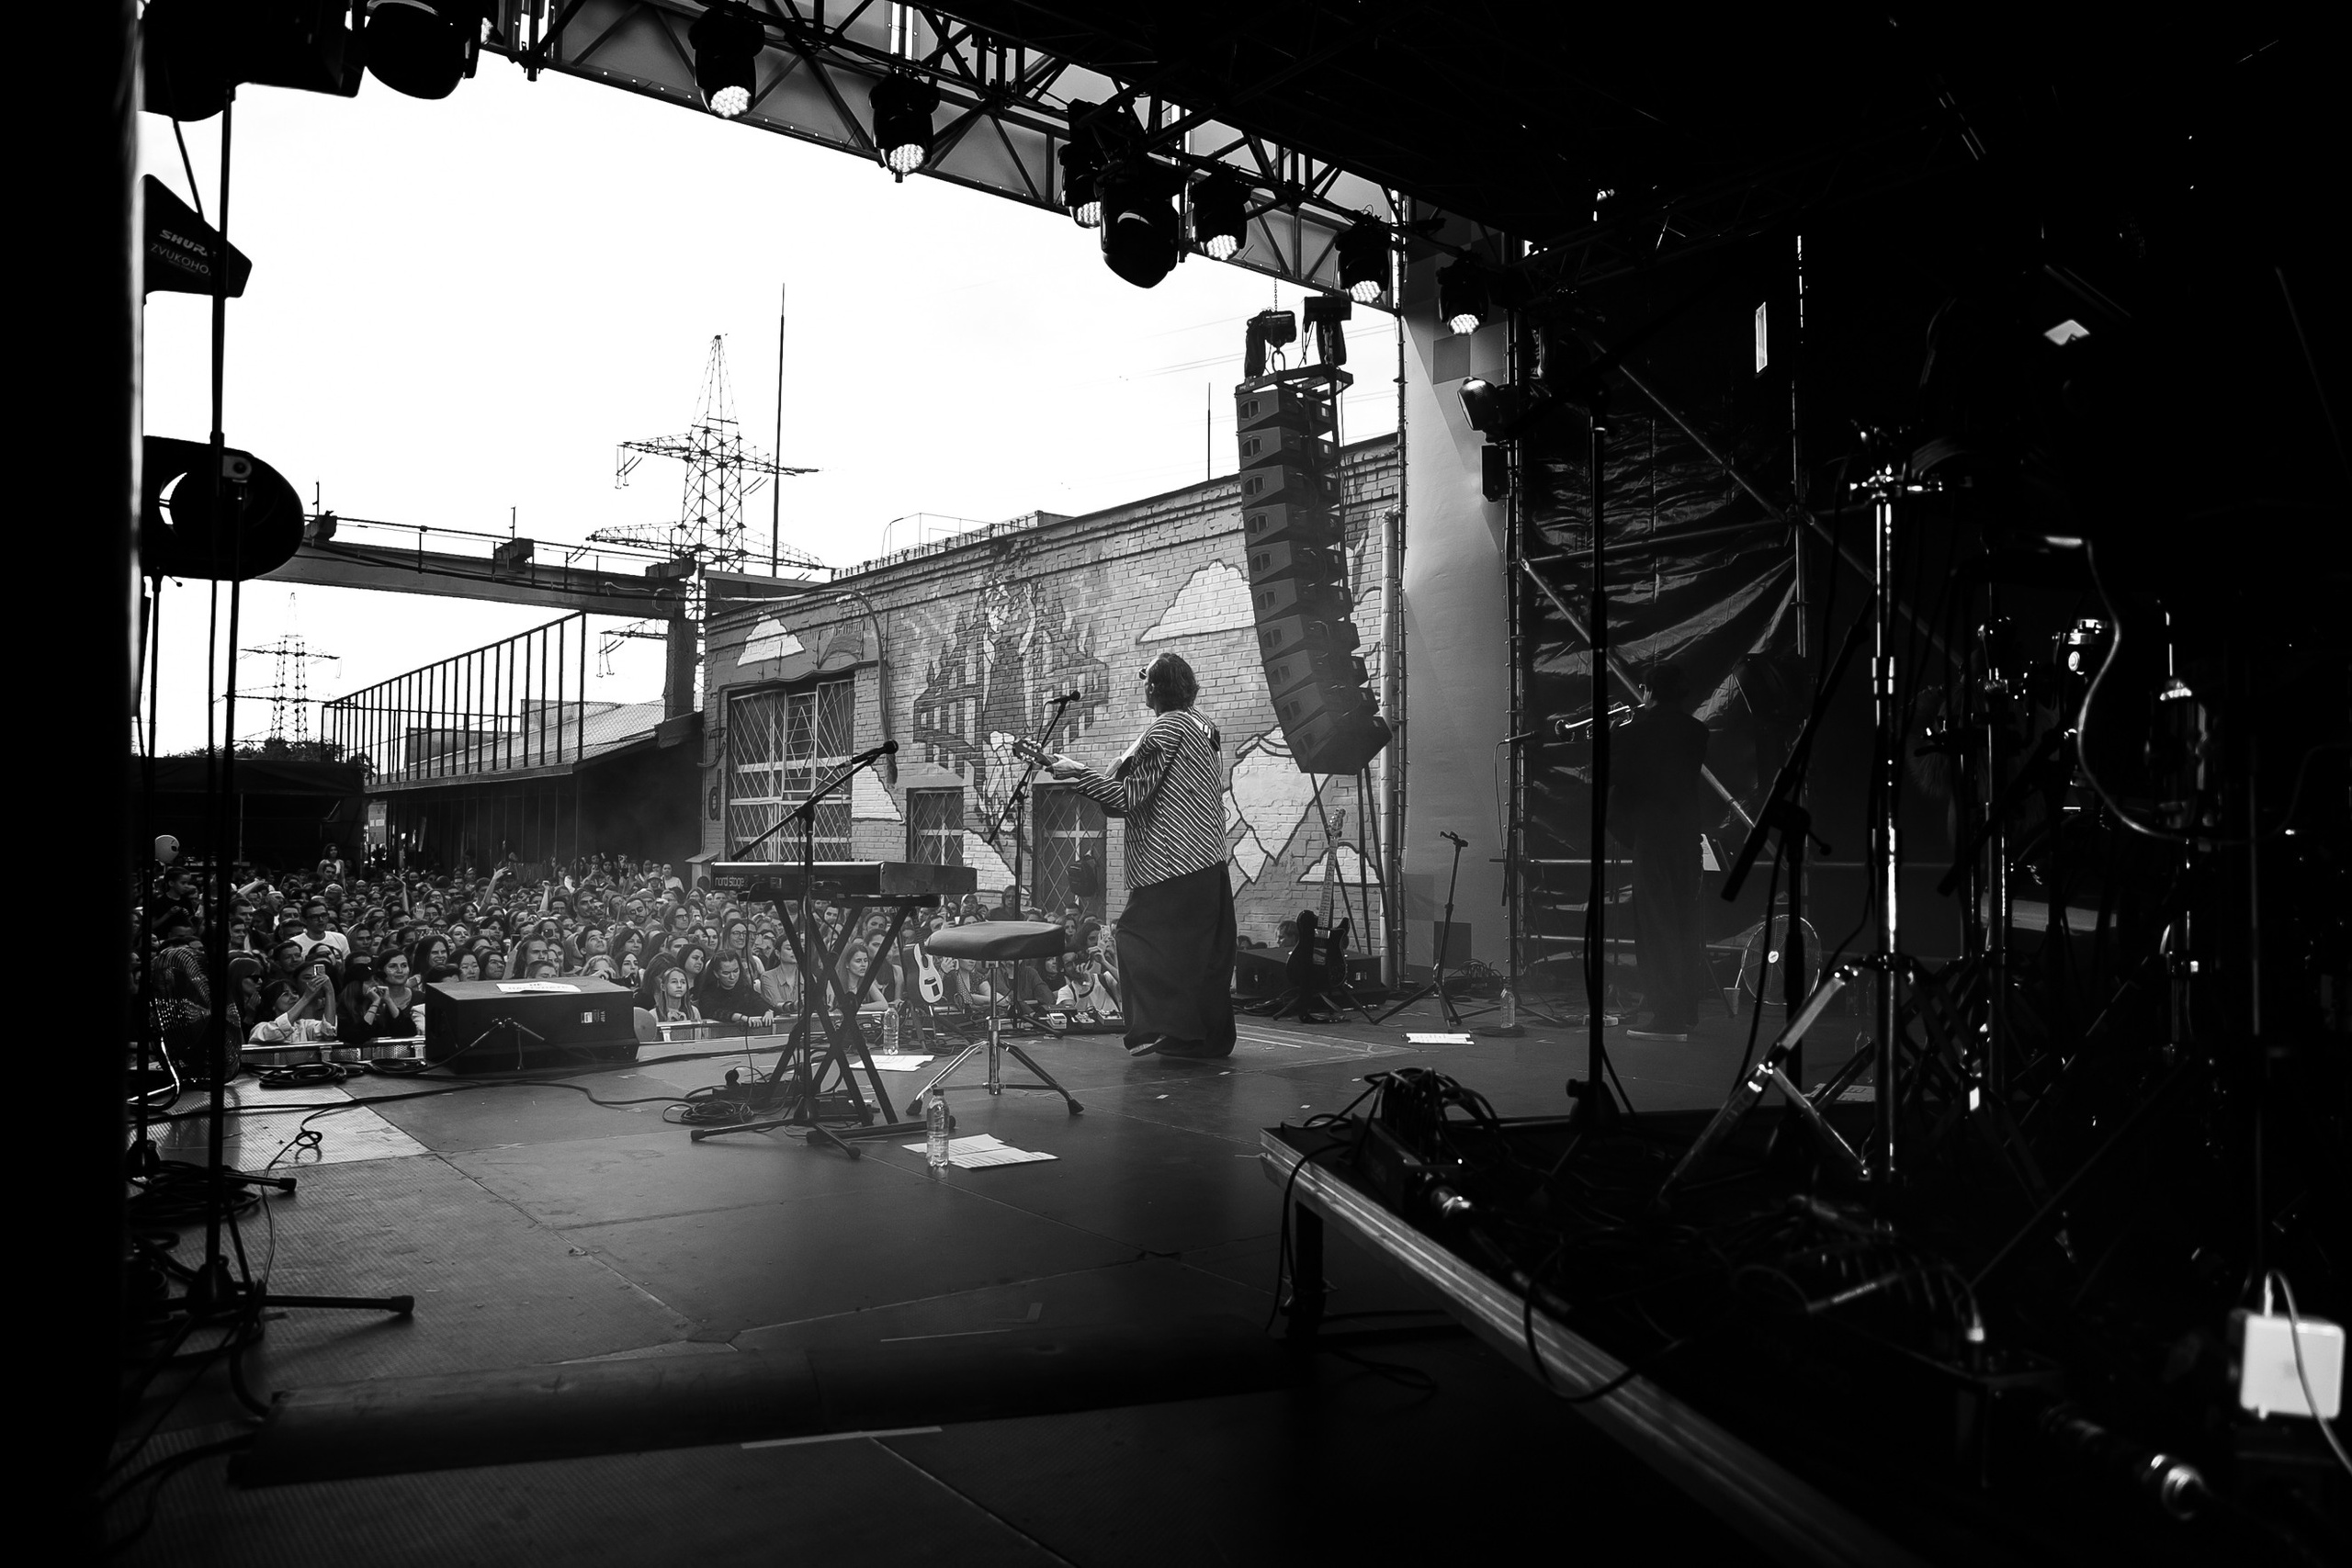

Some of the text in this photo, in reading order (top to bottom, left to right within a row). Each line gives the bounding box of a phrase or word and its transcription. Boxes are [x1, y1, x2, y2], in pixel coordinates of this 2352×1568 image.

[159, 230, 217, 257] SHUR
[714, 875, 729, 886] nord
[729, 875, 745, 889] stage
